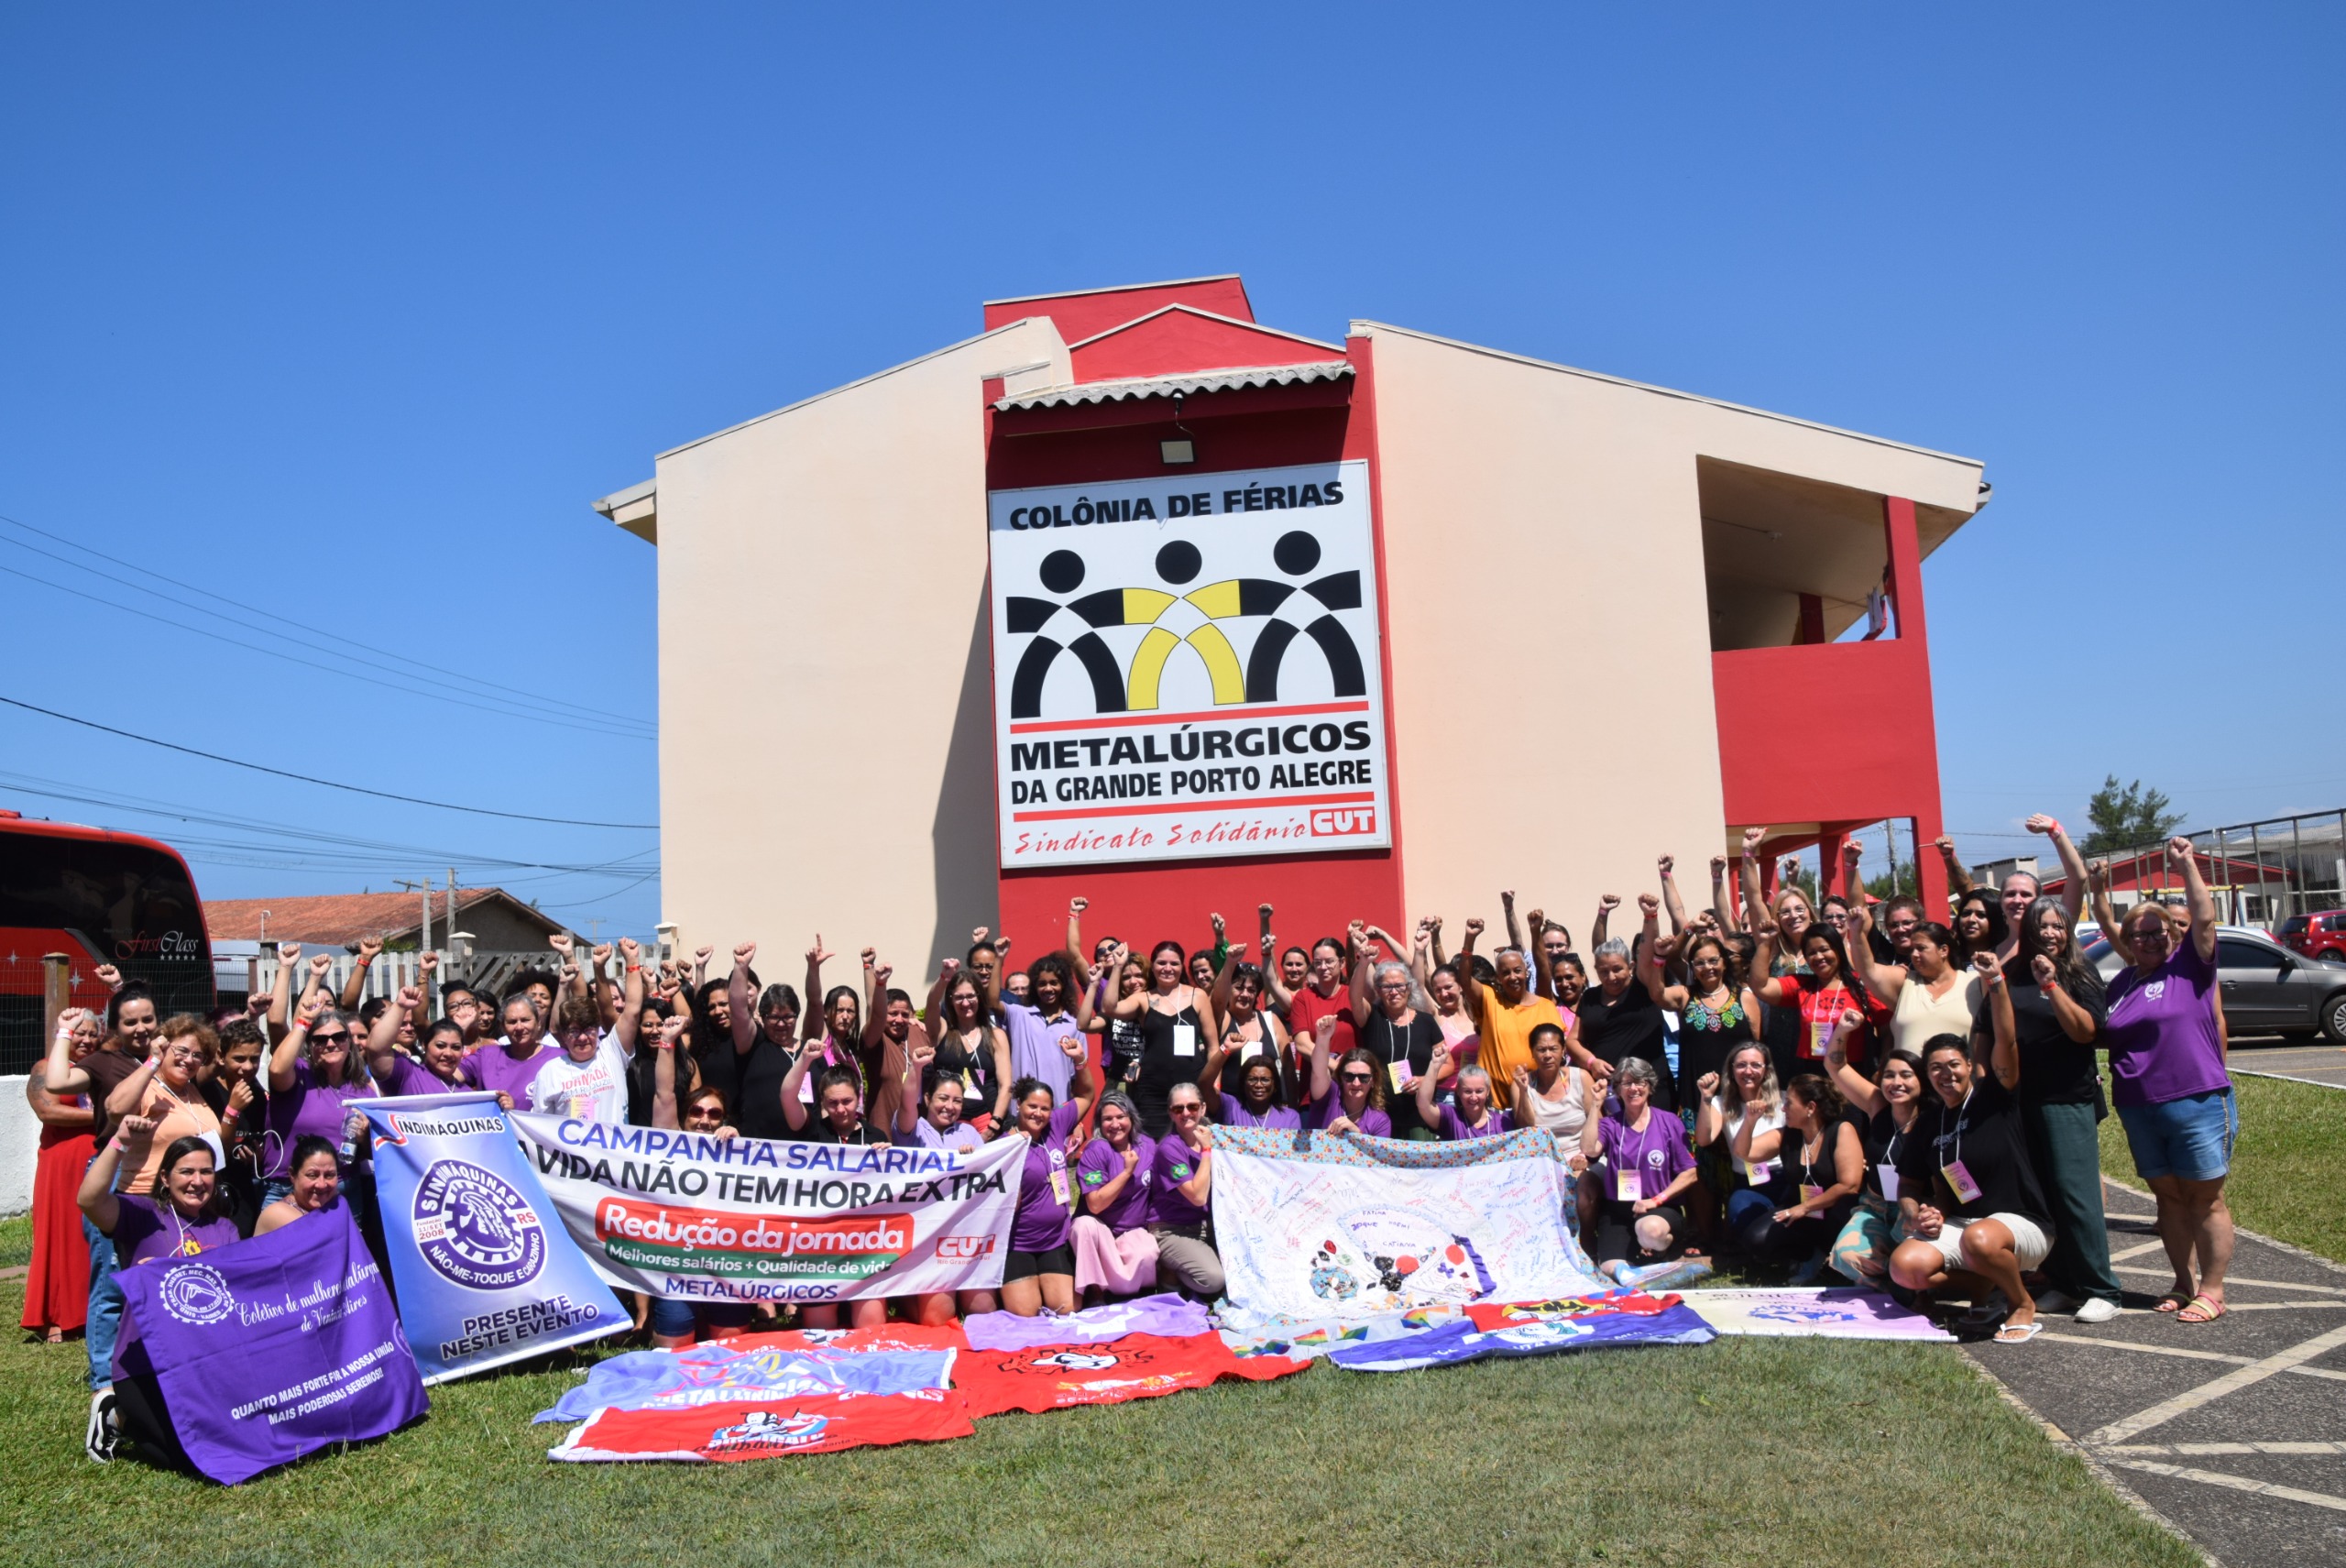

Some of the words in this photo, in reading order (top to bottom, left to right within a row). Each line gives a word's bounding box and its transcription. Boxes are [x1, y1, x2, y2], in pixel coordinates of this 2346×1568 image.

[1010, 497, 1157, 531] COLÔNIA
[1168, 492, 1211, 518] DE
[1222, 482, 1344, 513] FÉRIAS
[1011, 721, 1371, 771] METALÚRGICOS
[1012, 780, 1047, 805] DA
[1056, 773, 1162, 801] GRANDE
[1171, 766, 1260, 795] PORTO
[1269, 759, 1372, 789] ALEGRE
[1014, 827, 1157, 854] Sindicato
[1312, 809, 1374, 834] CUT
[558, 1119, 778, 1168] CAMPANHA
[786, 1145, 965, 1174] SALARIAL
[535, 1145, 616, 1186] VIDA
[621, 1159, 708, 1196] NÃO
[715, 1171, 788, 1206] TEM
[794, 1179, 893, 1209] HORA
[898, 1168, 1006, 1202] EXTRA
[420, 1229, 444, 1240] 2008
[516, 1212, 536, 1224] RS
[604, 1204, 739, 1251] Redução
[741, 1220, 780, 1248] da
[781, 1220, 904, 1256] jornada
[430, 1245, 515, 1284] NÃO-ME-TOQUE
[609, 1244, 679, 1266] Melhores
[682, 1256, 742, 1271] salários
[756, 1258, 836, 1275] Qualidade
[839, 1262, 859, 1274] de
[938, 1235, 994, 1256] CUT
[665, 1277, 838, 1300] METALÚRGICOS
[235, 1301, 284, 1326] Coletivo
[286, 1293, 299, 1313] de
[301, 1315, 312, 1332] de
[464, 1295, 572, 1336] PRESENTE
[442, 1328, 510, 1359] NESTE
[516, 1304, 598, 1340] EVENTO
[231, 1394, 278, 1420] QUANTO
[279, 1386, 302, 1403] MAIS
[302, 1375, 329, 1393] FORTE
[340, 1367, 348, 1378] A
[346, 1352, 376, 1374] NOSSA
[374, 1341, 394, 1358] UNIÃO
[269, 1409, 296, 1425] MAIS
[298, 1388, 347, 1416] PODEROSAS
